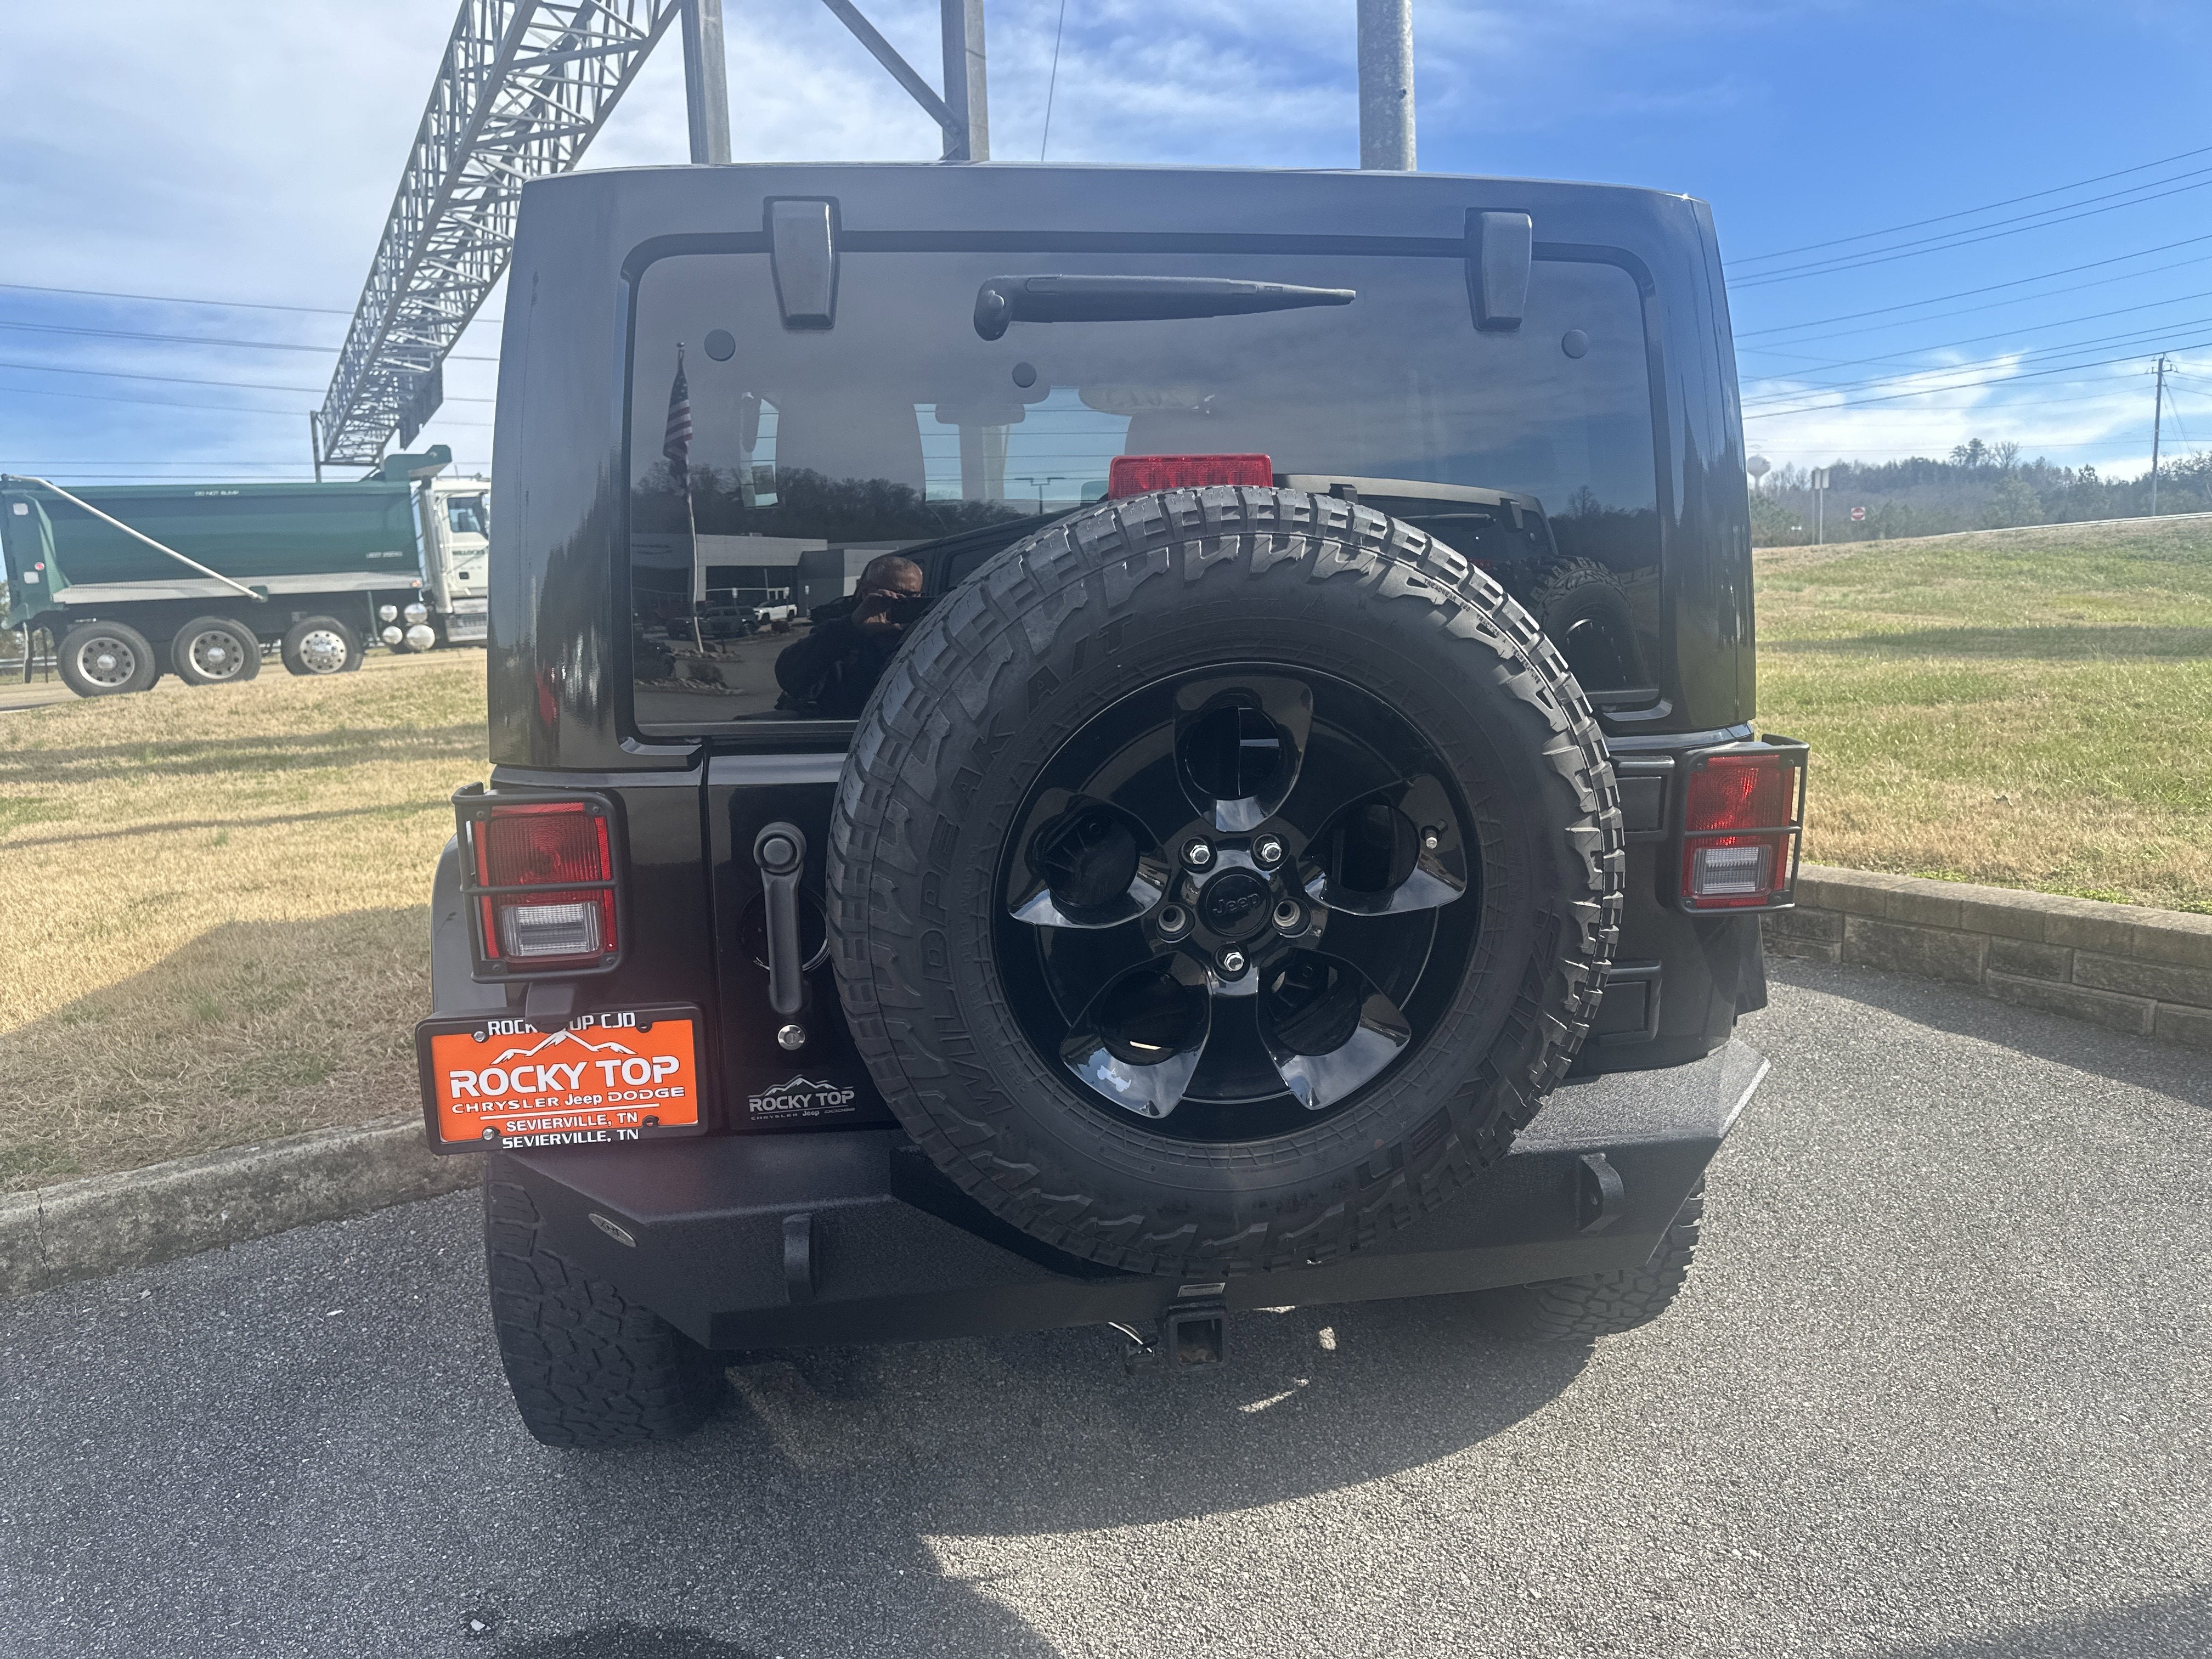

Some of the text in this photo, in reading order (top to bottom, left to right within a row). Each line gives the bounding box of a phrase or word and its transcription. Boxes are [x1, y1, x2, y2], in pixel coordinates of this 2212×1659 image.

[1212, 892, 1260, 915] Jeep
[487, 1012, 636, 1036] ROCK OP CJD
[449, 1056, 680, 1098] ROCKY TOP
[452, 1087, 685, 1114] CHRYSLER Jeep DODGE
[749, 1090, 855, 1112] ROCKY TOP
[506, 1112, 638, 1132] SEVIERVILLE, TN
[503, 1129, 639, 1149] SEVIERVILLE, TN
